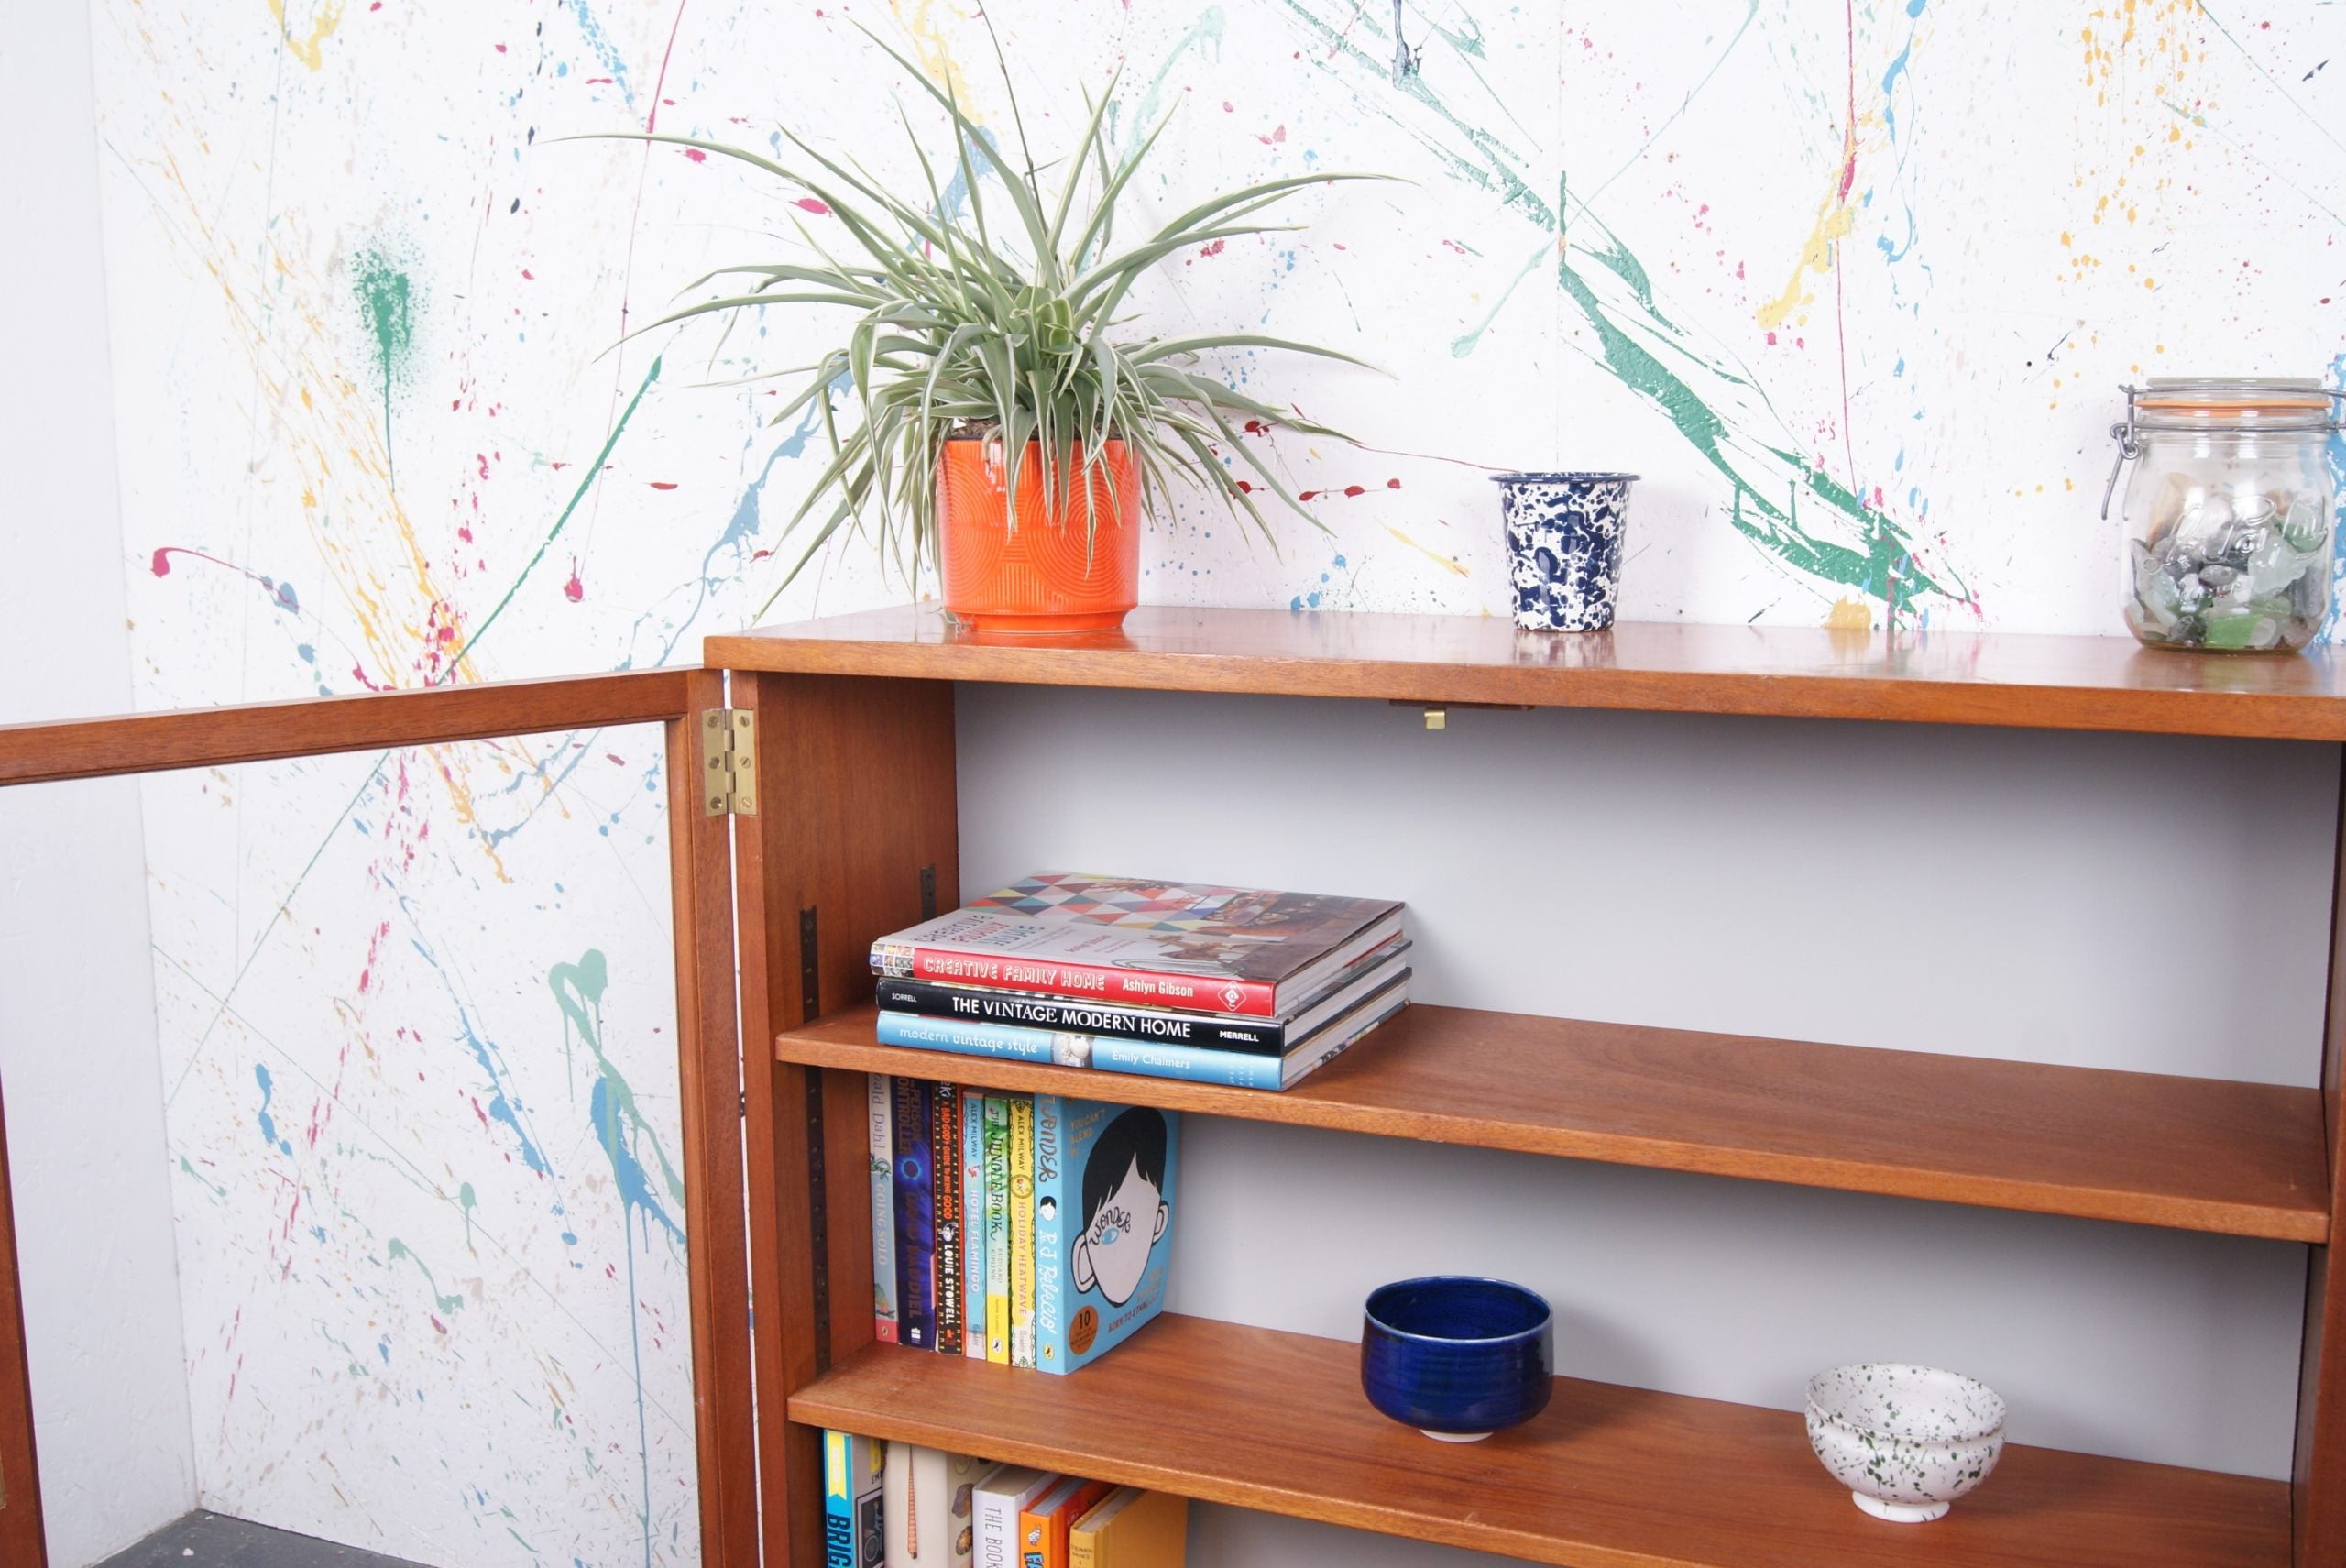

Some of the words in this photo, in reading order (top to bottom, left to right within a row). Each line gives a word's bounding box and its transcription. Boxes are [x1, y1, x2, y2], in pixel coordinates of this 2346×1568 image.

[923, 957, 998, 980] CREATIVE
[1003, 964, 1058, 985] FAMILY
[1061, 970, 1105, 991] HOME
[1123, 978, 1156, 994] Ashlyn
[1158, 981, 1193, 998] Gibson
[891, 992, 917, 1003] SORRELL
[952, 996, 980, 1014] THE
[983, 1000, 1058, 1023] VINTAGE
[1061, 1009, 1135, 1032] MODERN
[1140, 1020, 1191, 1038] HOME
[899, 1026, 948, 1044] modern
[952, 1033, 1003, 1052] vintage
[1007, 1037, 1038, 1056] style
[1219, 1030, 1259, 1042] MERRELL
[1112, 1051, 1138, 1066] Emily
[1142, 1055, 1191, 1069] Chalmers
[873, 1113, 886, 1149] Dahl
[898, 1078, 914, 1154] ONTROLLER
[941, 1108, 951, 1124] BAD
[991, 1112, 1000, 1134] THE
[943, 1146, 951, 1166] GUIDE
[990, 1133, 1003, 1191] JUNGLE
[943, 1175, 951, 1193] BEING
[876, 1183, 887, 1228] GOING
[942, 1195, 953, 1220] GOOD
[970, 1190, 979, 1228] HOTEL
[990, 1191, 1003, 1241] BOOK
[1018, 1201, 1026, 1251] HOLIDAY
[1038, 1229, 1058, 1245] R
[877, 1232, 888, 1266] SOLO
[944, 1245, 954, 1275] LOUIE
[970, 1232, 980, 1293] FLAMINGO
[1039, 1246, 1058, 1260] J
[1018, 1255, 1027, 1316] HEATWAVE
[945, 1278, 955, 1325] STOWELL
[1080, 1310, 1091, 1329] 10
[985, 1508, 1003, 1531] THE
